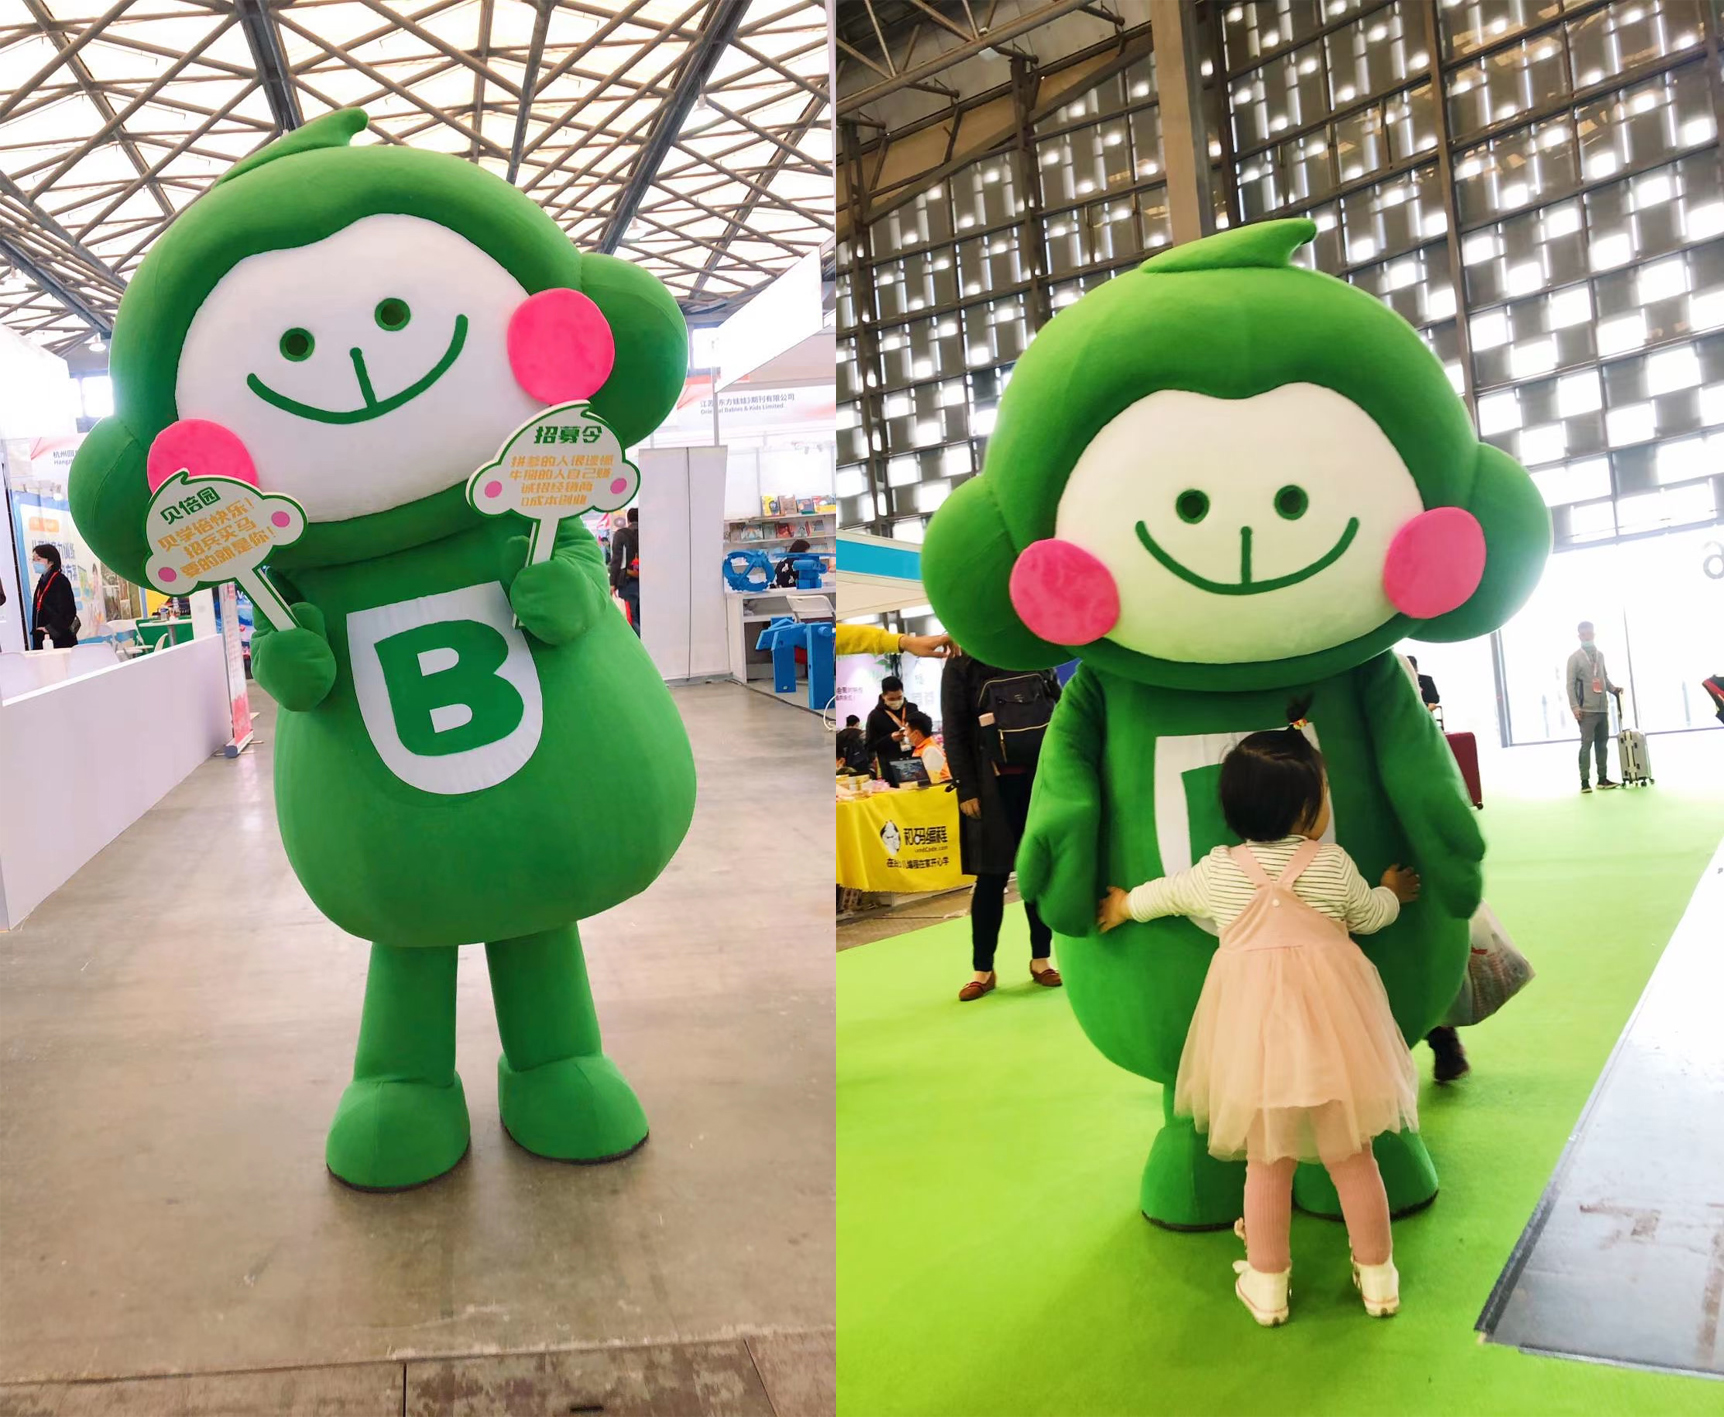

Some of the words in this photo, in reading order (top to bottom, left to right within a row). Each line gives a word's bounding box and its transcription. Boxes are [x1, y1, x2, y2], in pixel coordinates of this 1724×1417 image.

[533, 425, 602, 444] 招募令
[160, 486, 221, 525] 贝倍园
[183, 516, 257, 559] 招兵买马
[374, 619, 524, 757] B
